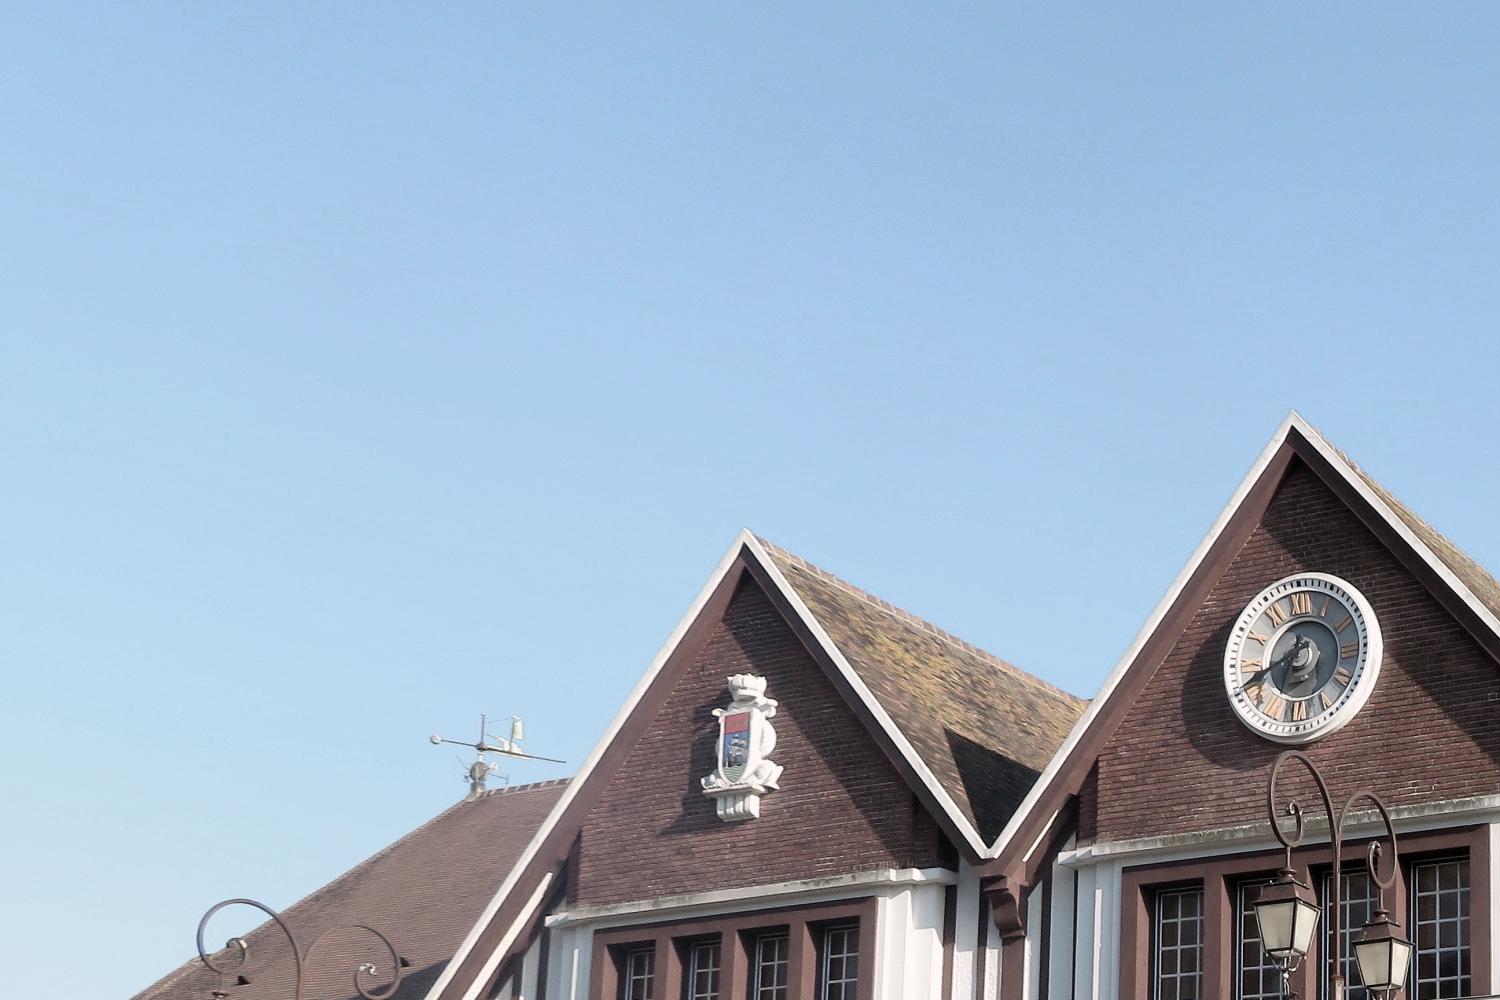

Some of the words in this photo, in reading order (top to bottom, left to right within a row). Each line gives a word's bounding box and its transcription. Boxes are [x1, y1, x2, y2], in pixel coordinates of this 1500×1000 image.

[1290, 593, 1311, 616] XII
[1265, 603, 1287, 627] XI
[1335, 614, 1354, 634] II
[1248, 629, 1268, 646] X
[1240, 659, 1264, 674] IX
[1291, 701, 1308, 721] VI
[1320, 691, 1334, 711] V
